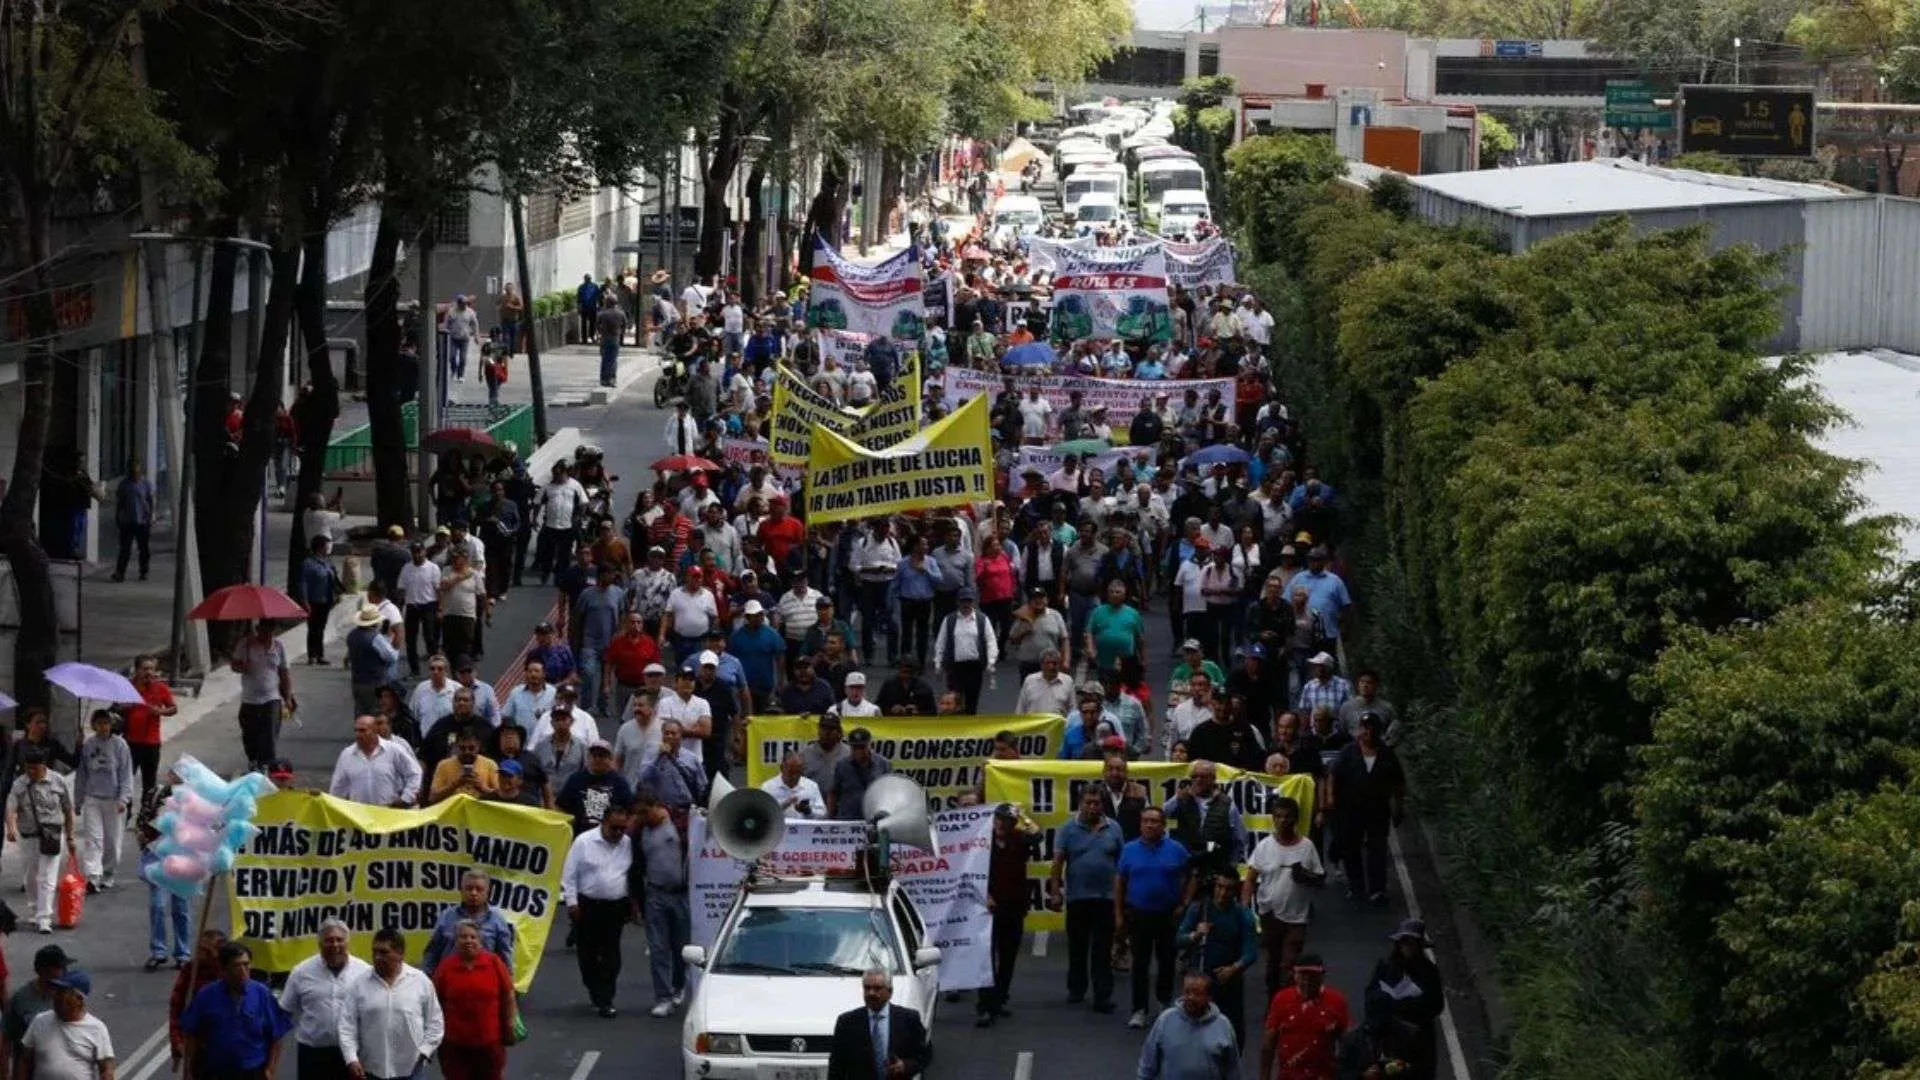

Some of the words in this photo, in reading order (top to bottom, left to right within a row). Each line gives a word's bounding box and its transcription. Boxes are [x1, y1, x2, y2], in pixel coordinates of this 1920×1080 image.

[1743, 101, 1770, 118] 1.5
[1070, 277, 1109, 288] RUTA
[1114, 277, 1138, 288] 43
[872, 457, 897, 477] PIE
[900, 453, 922, 472] DE
[925, 447, 982, 469] LUCHA
[825, 490, 855, 510] UNA
[856, 480, 911, 506] TARIFA
[913, 474, 966, 498] JUSTA
[253, 821, 311, 857] MÁS
[316, 828, 346, 857] DE
[782, 851, 848, 863] GOBIERNO
[343, 863, 358, 893] Y
[367, 860, 414, 891] SIN
[243, 910, 275, 939] DE
